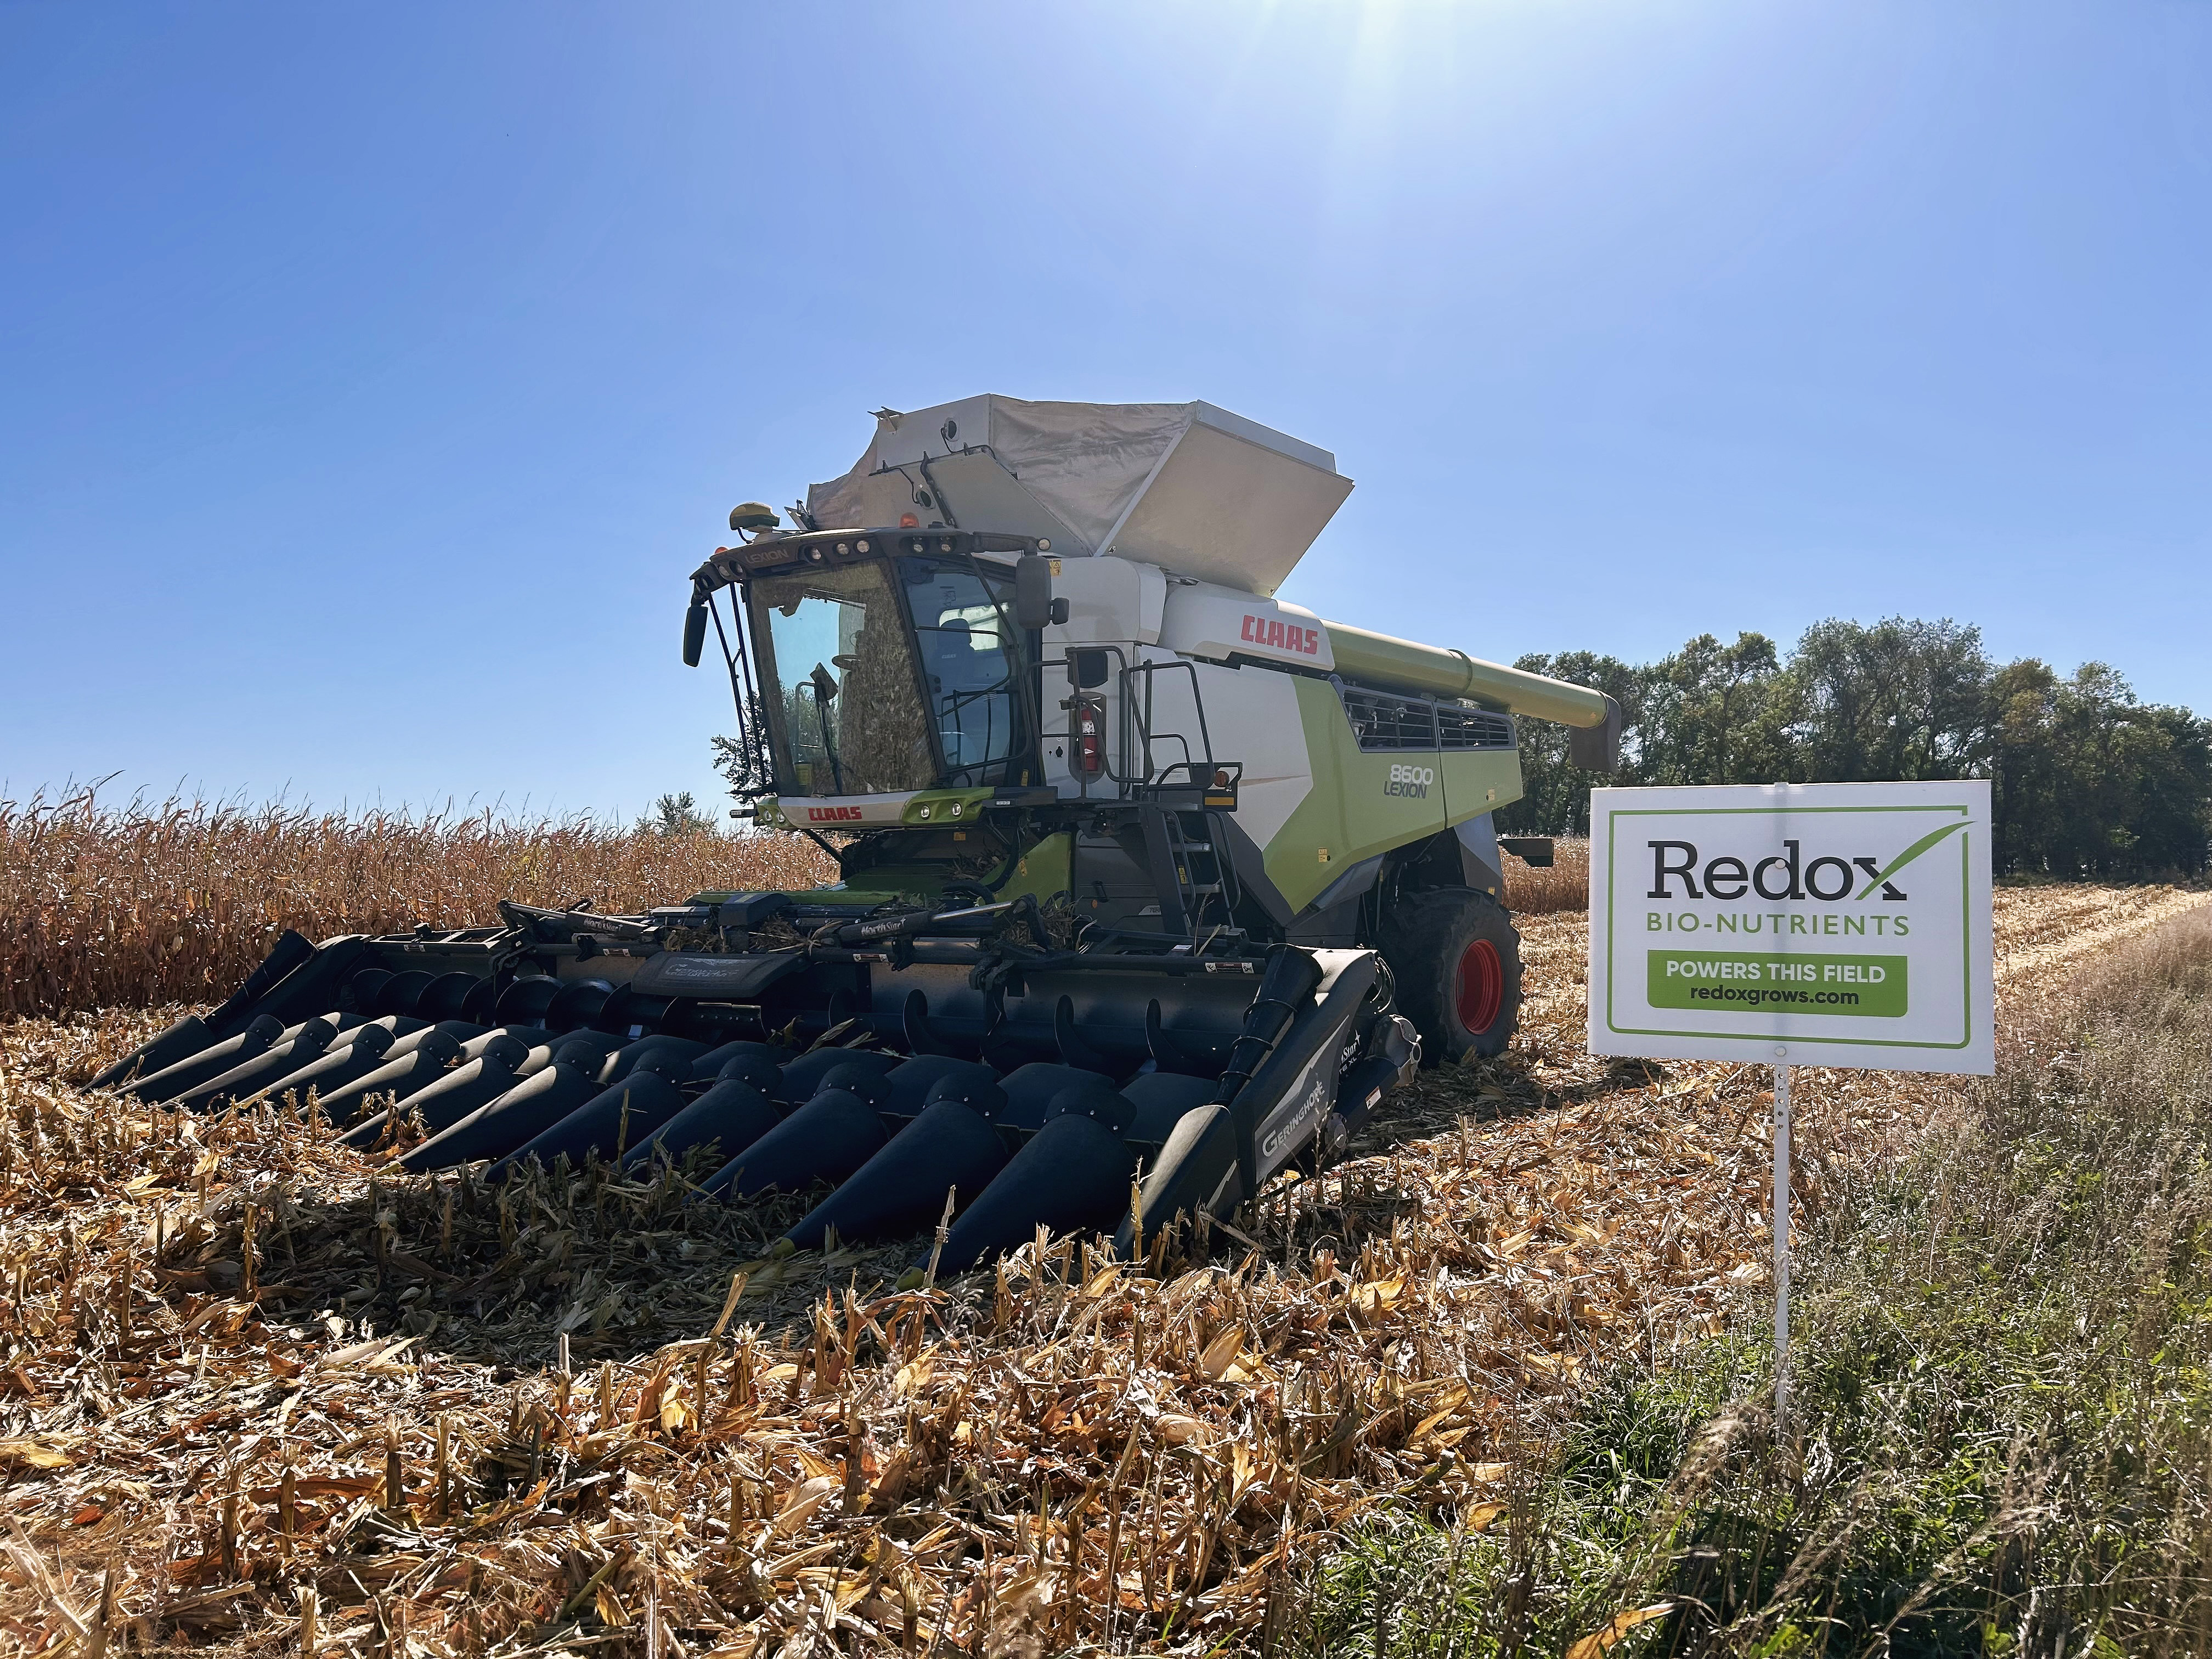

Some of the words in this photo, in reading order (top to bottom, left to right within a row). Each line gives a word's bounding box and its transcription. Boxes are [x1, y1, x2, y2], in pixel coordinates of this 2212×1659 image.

[745, 549, 790, 564] LEXION
[1241, 614, 1318, 655] CLAAS
[1390, 764, 1434, 785] 8600
[1383, 781, 1427, 799] LEXION
[808, 806, 862, 821] CLAAS
[1646, 839, 1908, 901] Redox
[1646, 912, 1909, 936] BIO-NUTRIENTS
[1666, 960, 1761, 980] POWERS
[1766, 962, 1817, 982] THIS
[1823, 964, 1886, 984] FIELD
[1690, 984, 1859, 1006] redoxgrows.com
